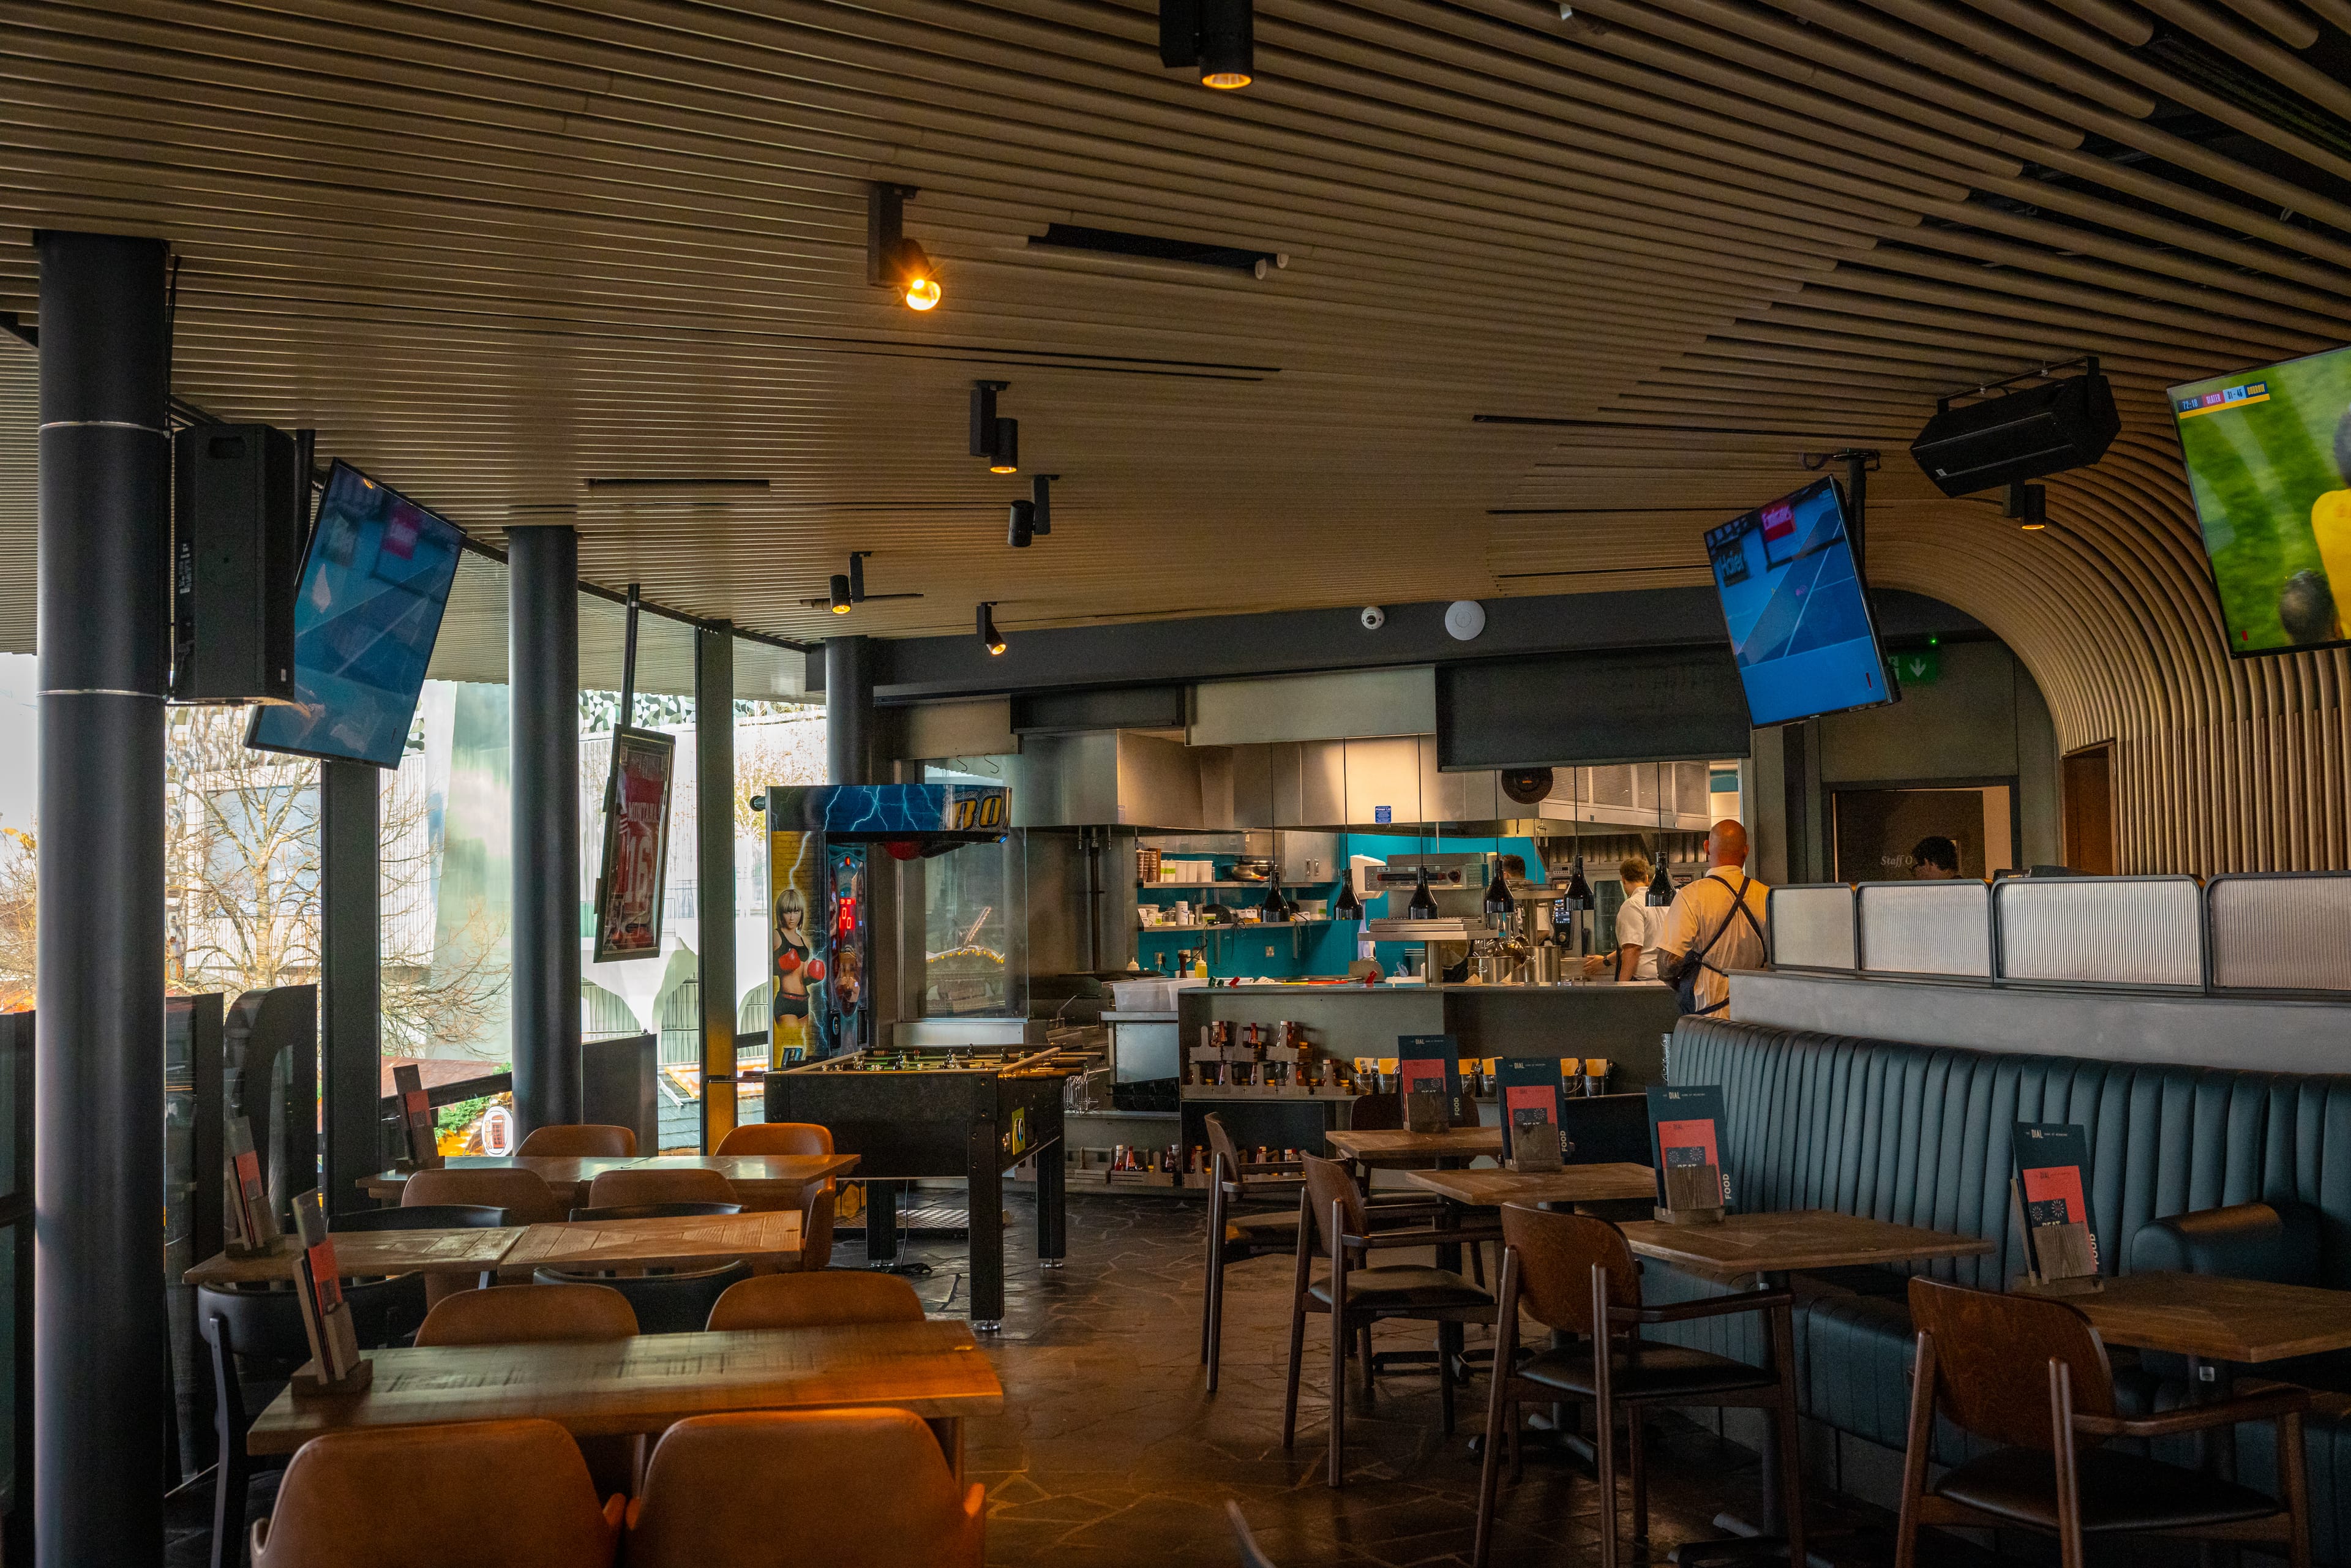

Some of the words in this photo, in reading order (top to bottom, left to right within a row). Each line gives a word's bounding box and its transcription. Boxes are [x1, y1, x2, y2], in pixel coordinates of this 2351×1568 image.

[2183, 399, 2198, 410] 72:18
[2206, 394, 2221, 404] SLATER
[2247, 384, 2265, 395] BURROW
[628, 801, 658, 823] MONTANA
[949, 795, 1002, 831] BO
[624, 836, 652, 903] 16
[1881, 855, 1904, 868] Staff
[1905, 856, 1913, 865] O
[2031, 1129, 2044, 1139] DIAL
[1722, 1173, 1732, 1199] FOOD
